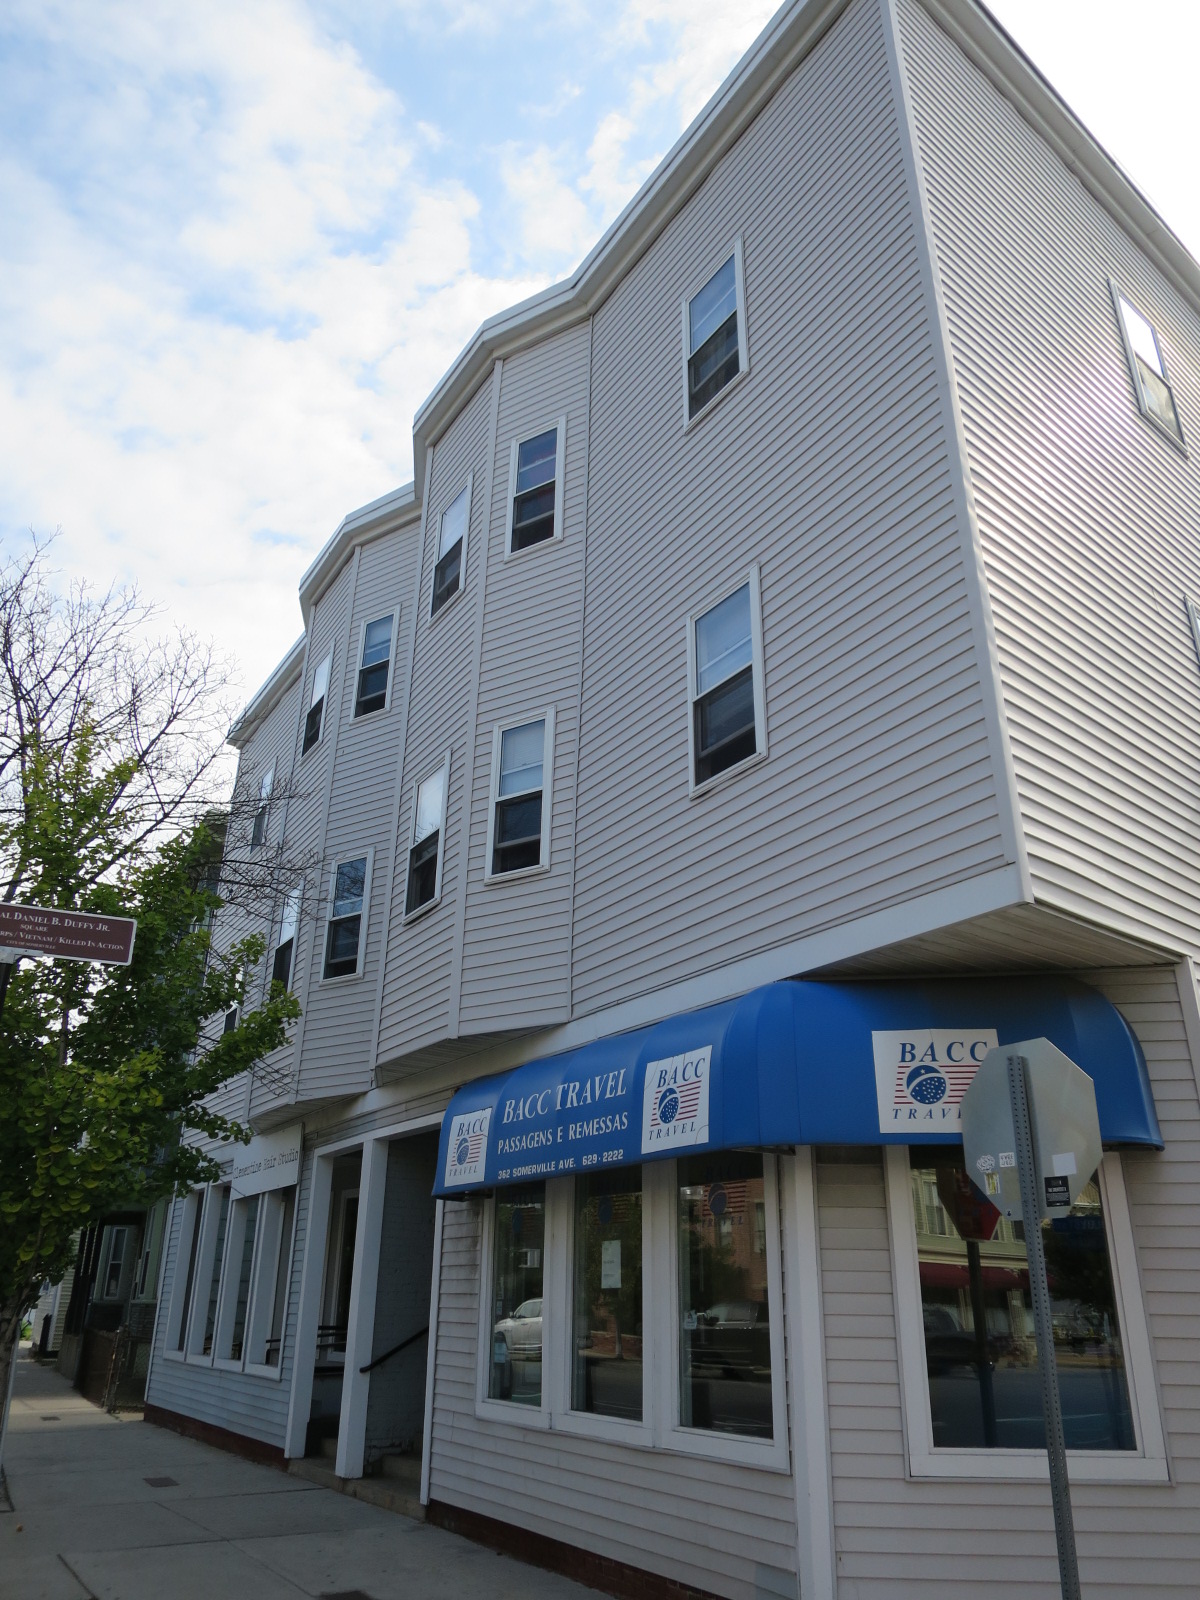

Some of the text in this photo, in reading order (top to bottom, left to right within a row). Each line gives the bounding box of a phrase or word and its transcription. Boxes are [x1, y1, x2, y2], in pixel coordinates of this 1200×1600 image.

[14, 911, 51, 925] DANIEL
[51, 917, 62, 926] B.
[64, 918, 96, 930] DUFFY
[96, 923, 111, 932] JR.
[20, 923, 49, 933] SQUARE
[19, 931, 54, 943] VIETNAM
[59, 936, 87, 947] KILLED
[87, 940, 96, 948] IN
[97, 942, 125, 951] ACTION
[899, 1041, 989, 1064] BACC
[657, 1057, 706, 1089] BACC
[502, 1067, 628, 1125] BACC TRAVEL
[892, 1107, 963, 1121] TRAV
[457, 1116, 488, 1136] BACC
[497, 1111, 629, 1155] PASSAGENS E REMESSAS
[648, 1120, 697, 1142] TRAVEL
[277, 1148, 299, 1166] Studio
[449, 1164, 480, 1178] TRAVEL
[497, 1168, 511, 1180] 362
[512, 1161, 556, 1179] SOMERVILLE
[558, 1158, 576, 1171] AVE.
